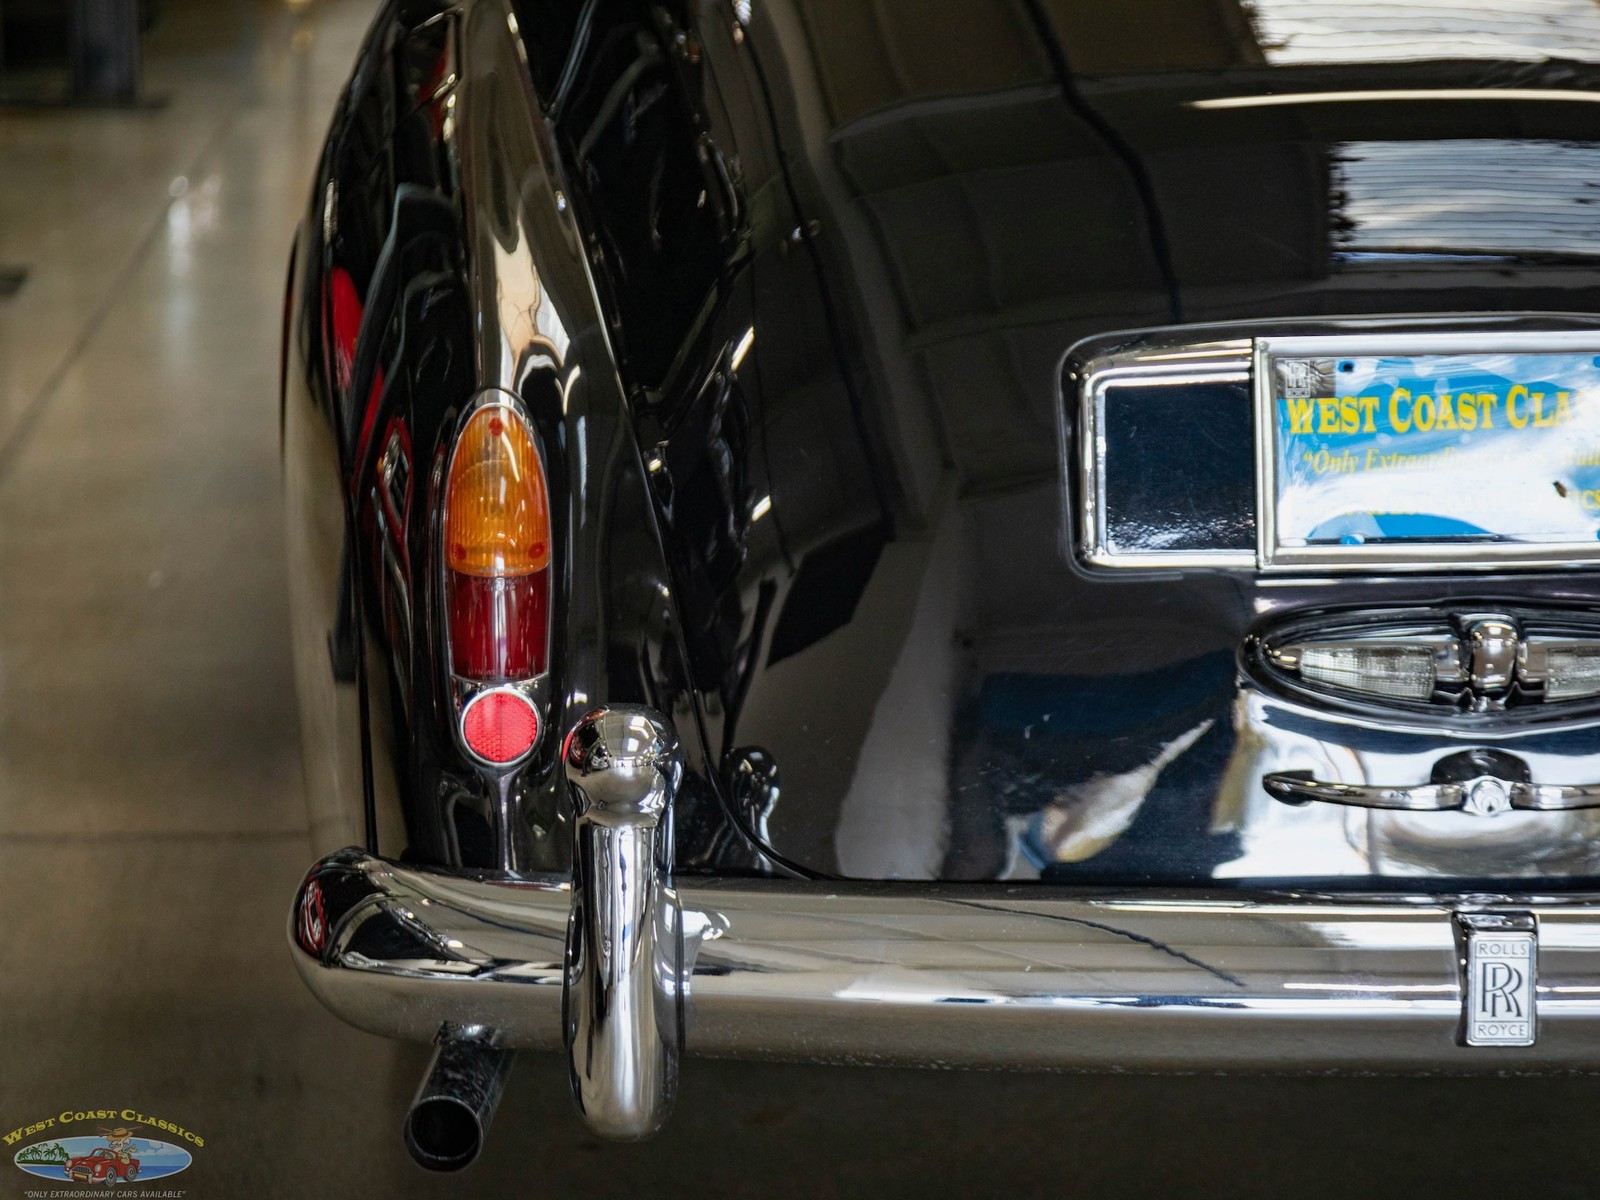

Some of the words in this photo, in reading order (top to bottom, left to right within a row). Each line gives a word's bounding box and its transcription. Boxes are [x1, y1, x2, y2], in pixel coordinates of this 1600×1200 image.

[1286, 395, 1380, 434] WEST
[1388, 387, 1498, 433] COAST
[1506, 383, 1588, 430] CLA
[1478, 943, 1527, 955] ROLLS
[1481, 961, 1523, 1018] RR
[1477, 1024, 1526, 1036] ROYCE
